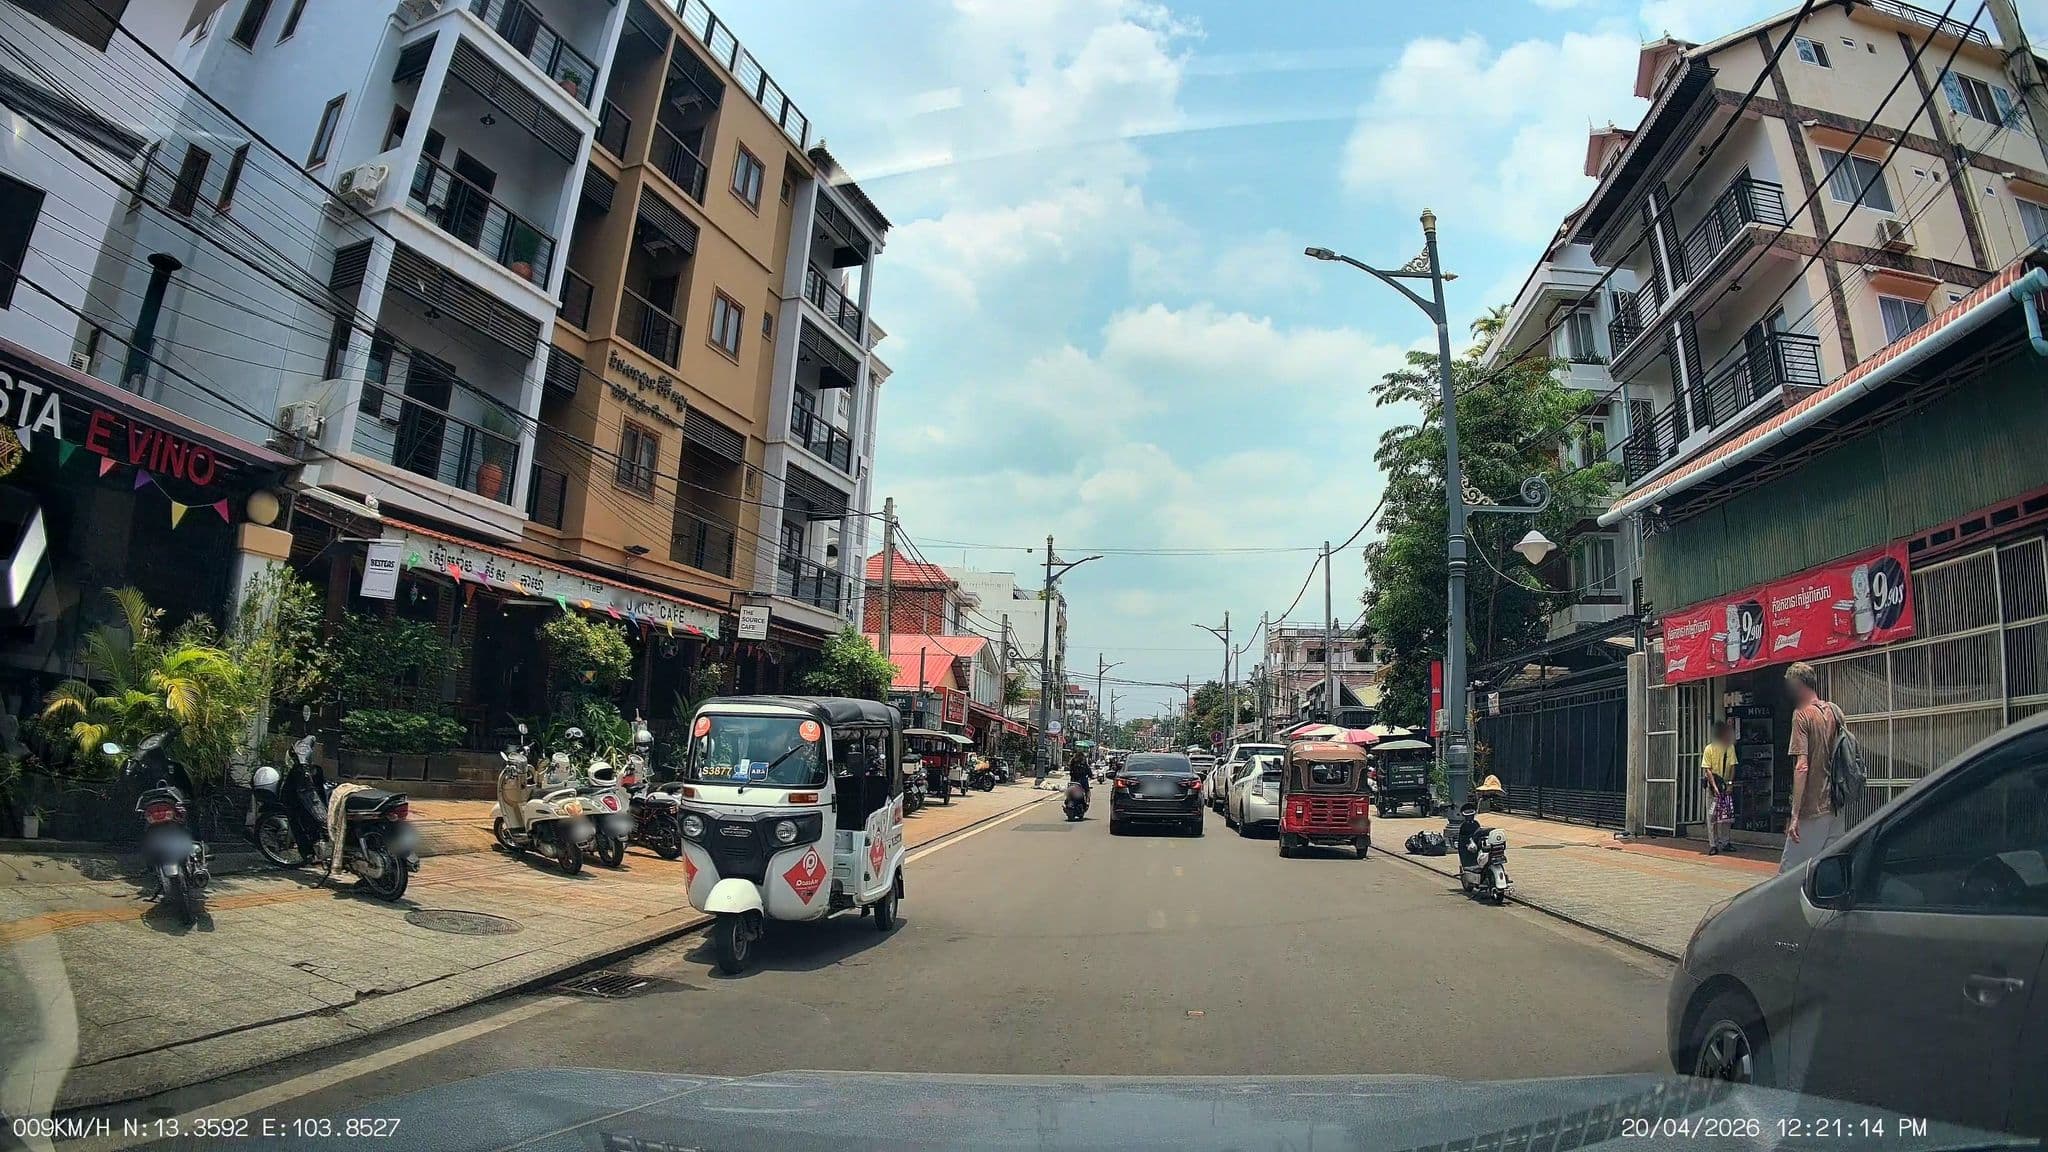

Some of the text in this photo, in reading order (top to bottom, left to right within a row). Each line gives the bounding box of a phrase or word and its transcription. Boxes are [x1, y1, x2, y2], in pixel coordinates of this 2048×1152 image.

[85, 409, 115, 456] E
[128, 420, 216, 486] VINO
[588, 583, 601, 594] THE
[742, 616, 765, 624] SOURCE
